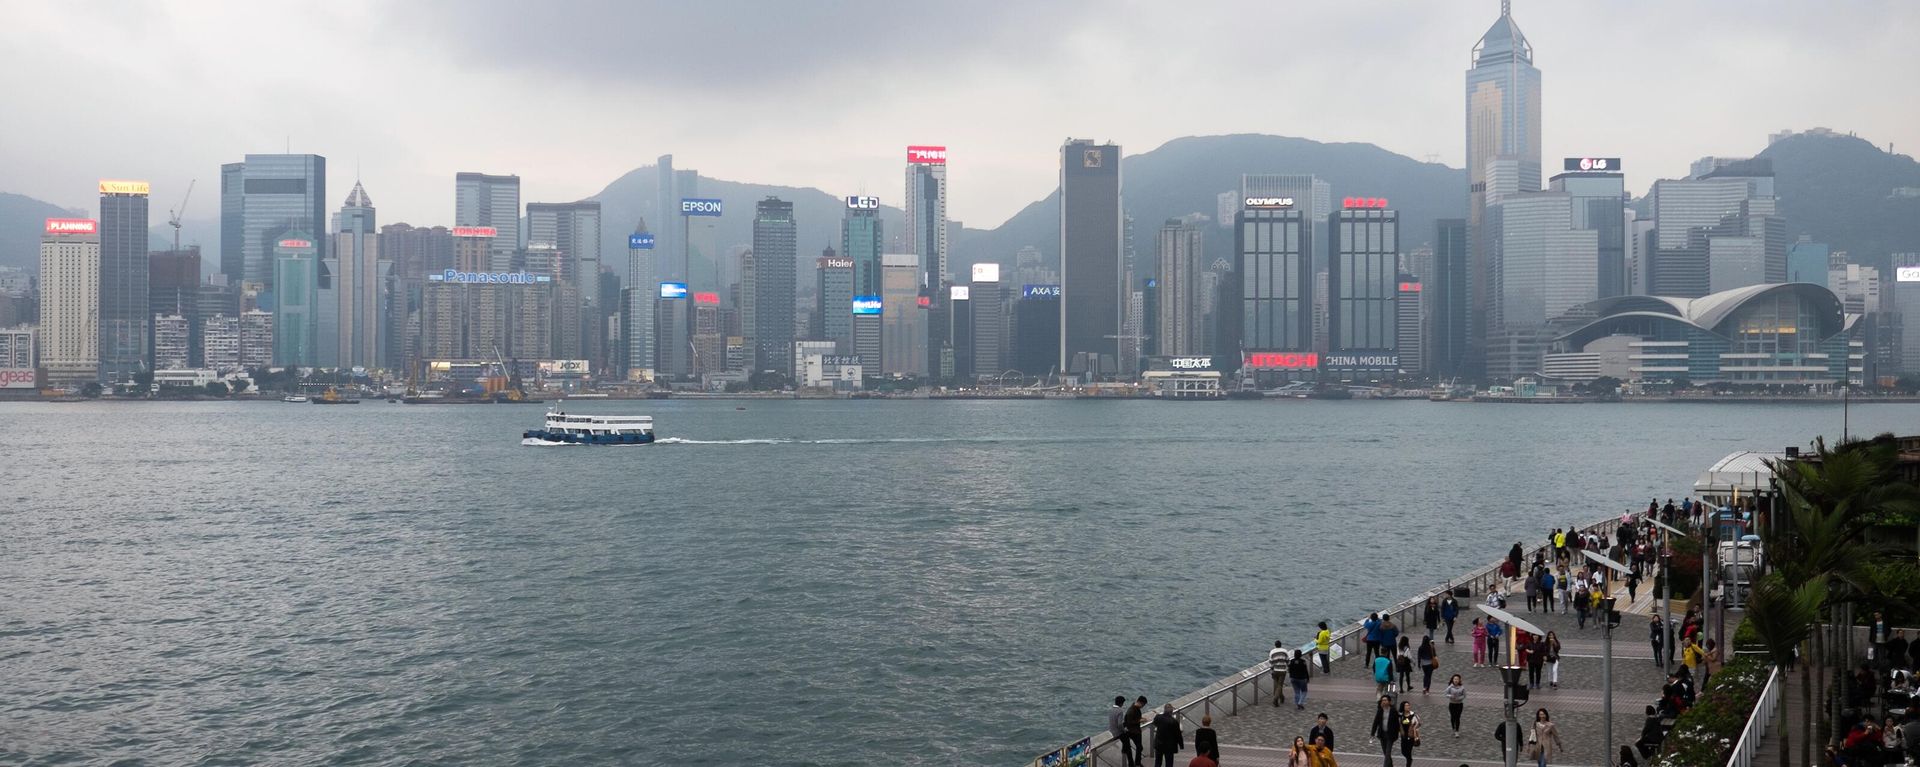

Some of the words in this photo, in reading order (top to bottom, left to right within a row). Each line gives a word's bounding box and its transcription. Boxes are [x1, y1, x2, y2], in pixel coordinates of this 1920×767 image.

[111, 183, 129, 192] Sun
[132, 183, 148, 192] Life
[1246, 198, 1293, 206] OLYMPUS
[682, 202, 721, 212] EPSON
[51, 222, 93, 231] PLANNING
[453, 227, 496, 236] TOSHIBA
[828, 259, 853, 268] Haier
[444, 269, 535, 284] Panasonic
[1030, 287, 1051, 295] AXA
[1172, 358, 1211, 369] 中国太平
[1326, 356, 1357, 366] CHINA
[1360, 356, 1398, 366] MOBILE
[0, 371, 34, 387] geas
